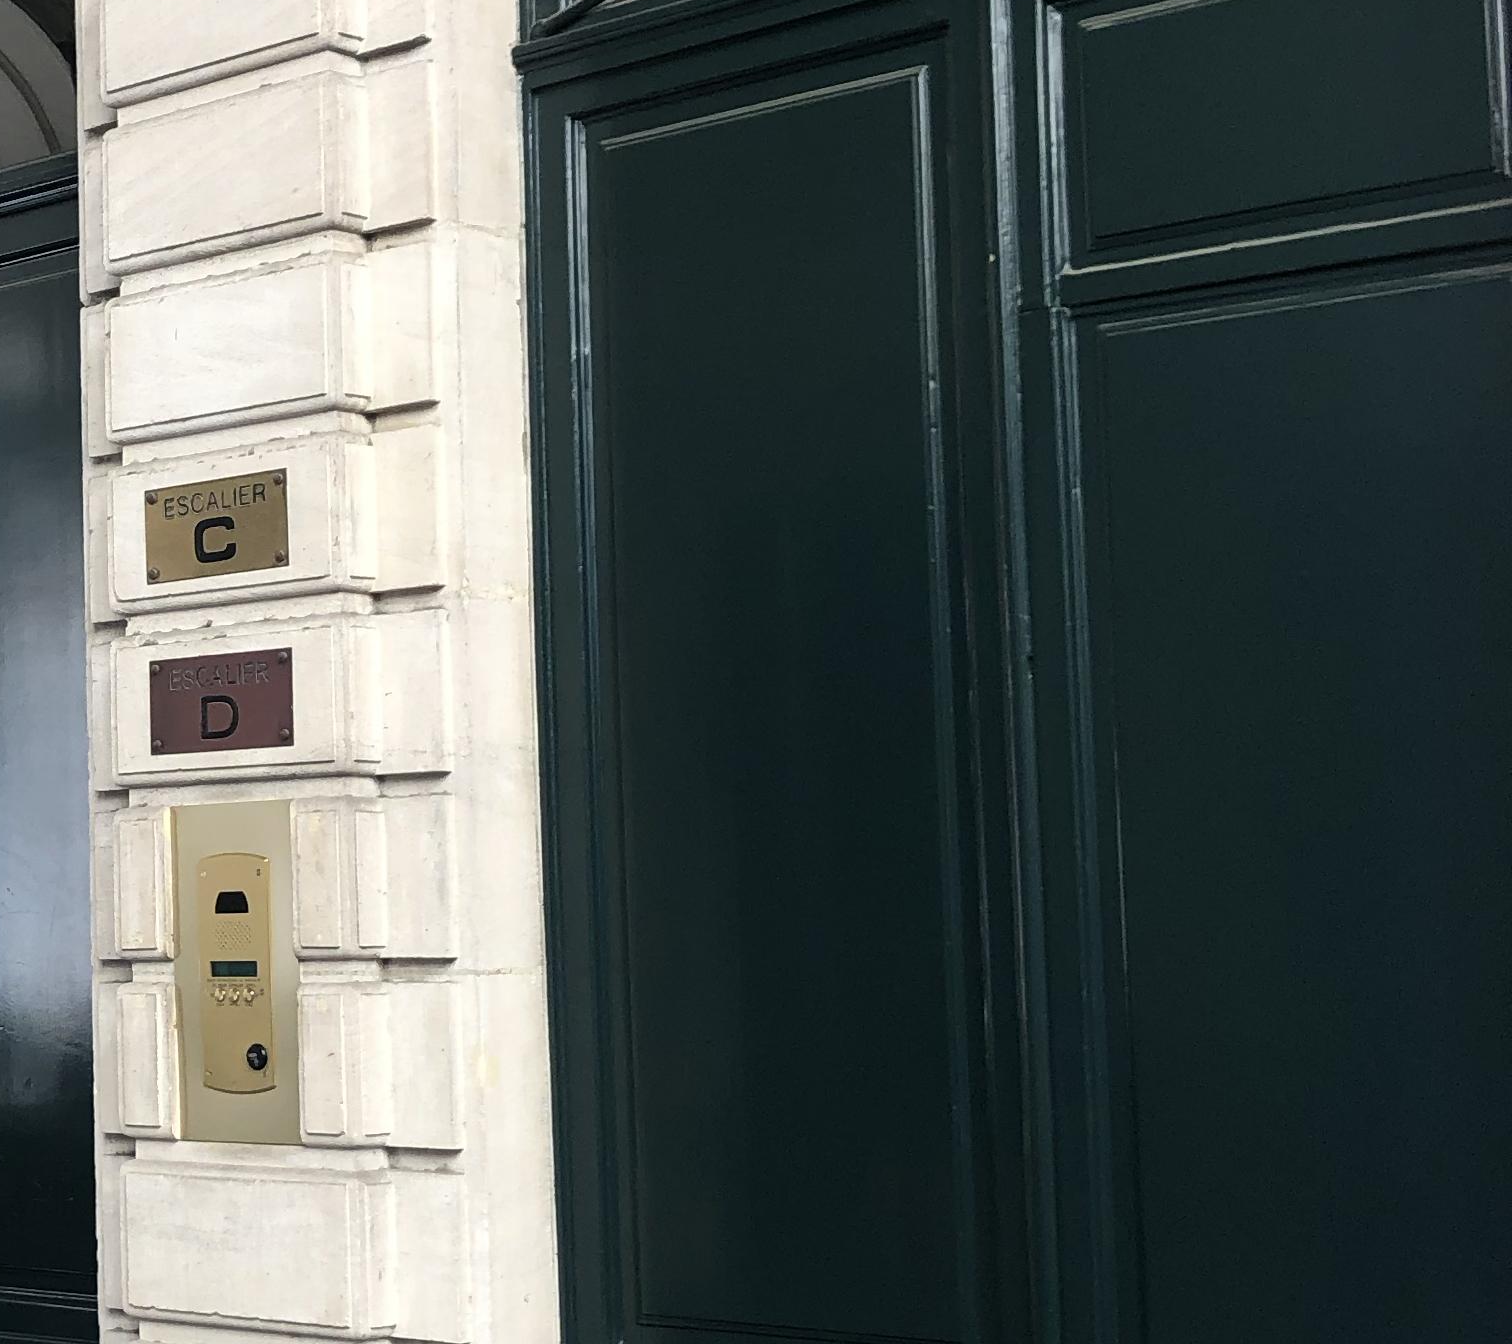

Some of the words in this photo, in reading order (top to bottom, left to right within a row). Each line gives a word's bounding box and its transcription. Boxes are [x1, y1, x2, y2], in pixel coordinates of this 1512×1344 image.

[164, 483, 266, 519] ESCALIER
[194, 516, 236, 563] C
[169, 662, 270, 691] ESCALIER
[201, 695, 238, 739] D
